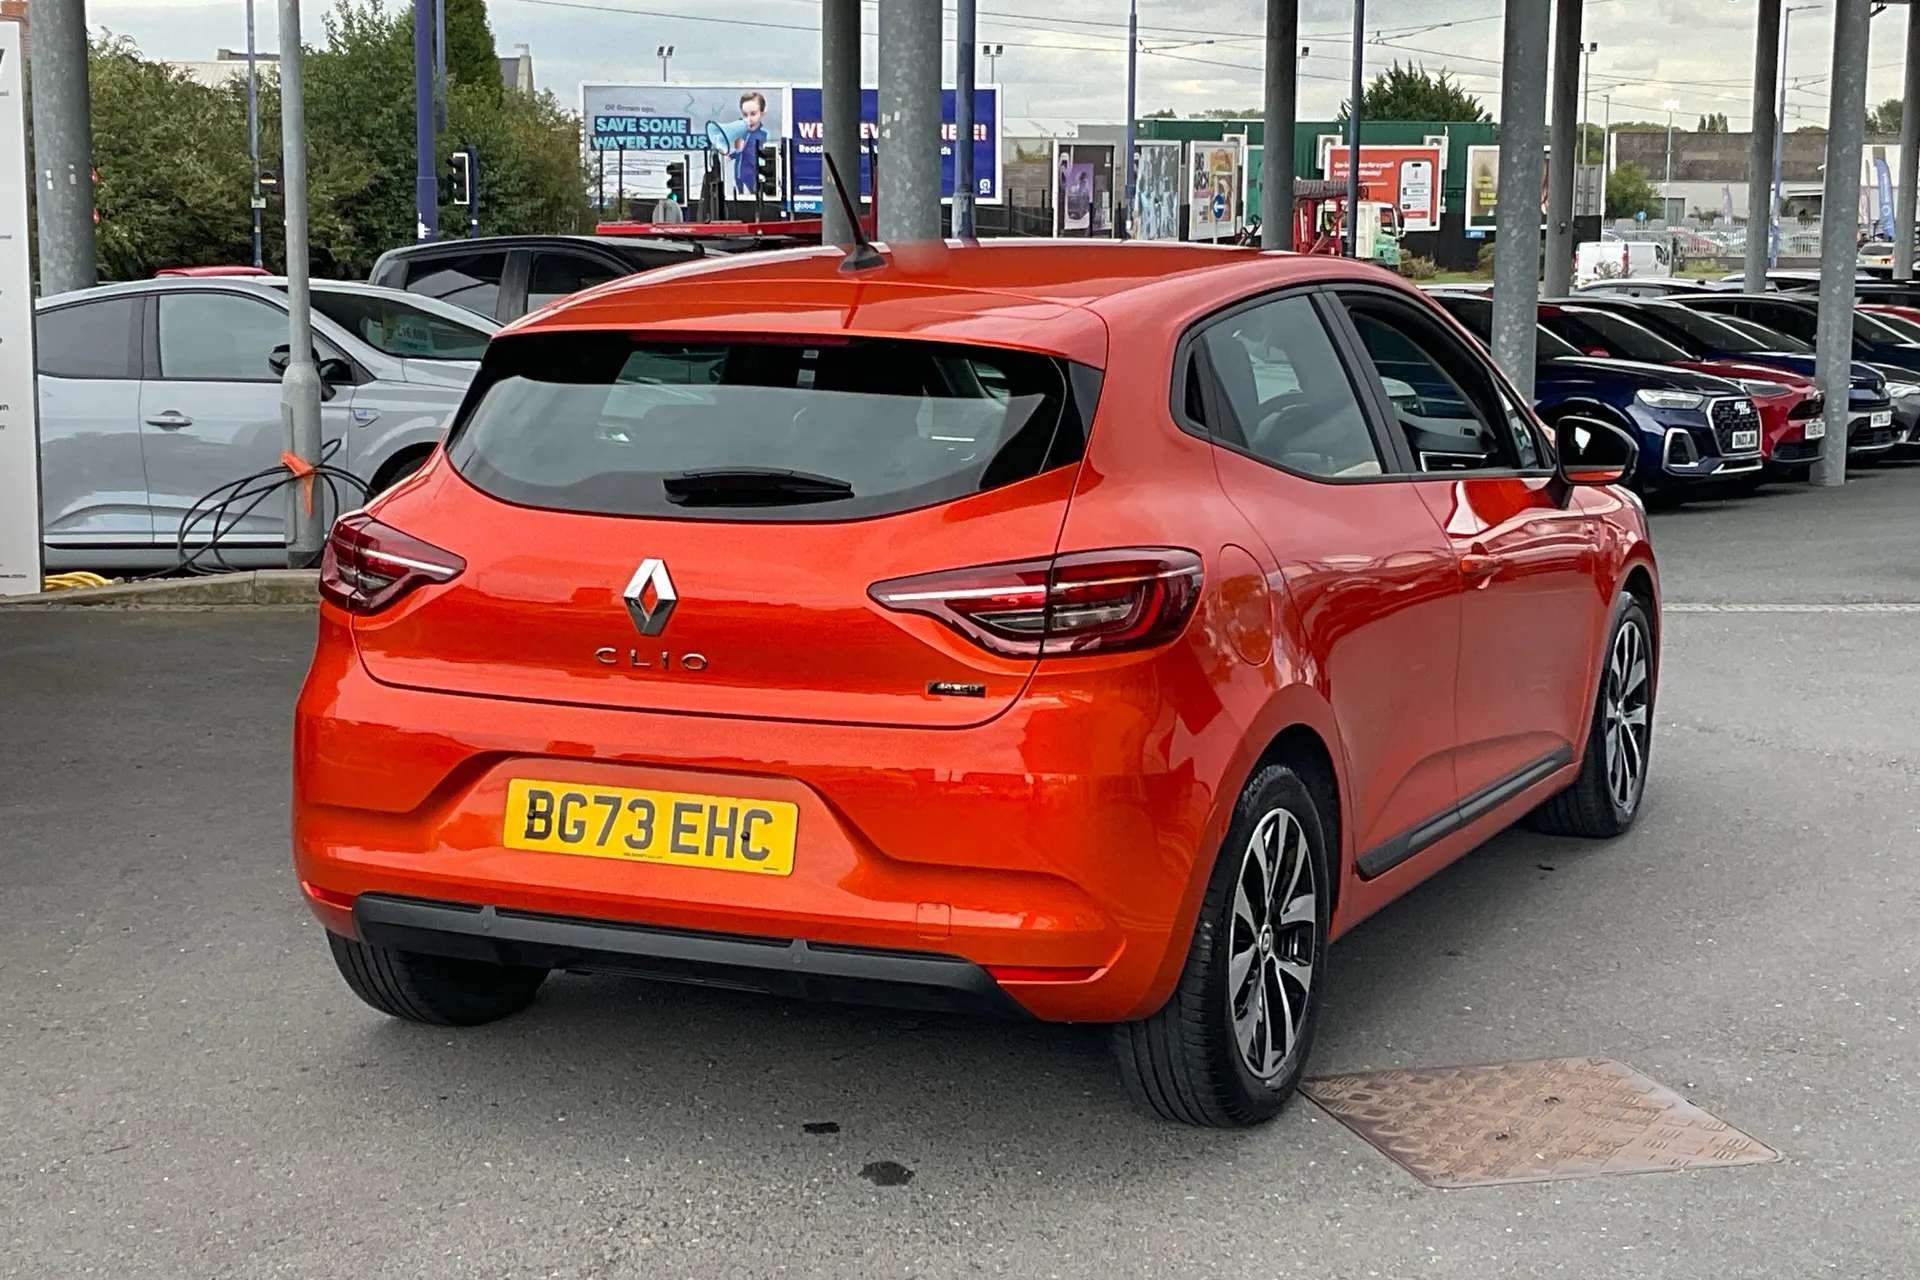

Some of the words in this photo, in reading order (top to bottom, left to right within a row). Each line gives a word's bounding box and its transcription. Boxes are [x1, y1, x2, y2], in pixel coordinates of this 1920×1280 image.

[596, 117, 637, 132] SAVE
[639, 118, 687, 133] SOME
[593, 135, 649, 150] WATER
[651, 135, 684, 150] FOR
[686, 136, 708, 149] US
[794, 202, 816, 211] global
[594, 647, 708, 671] CLIO
[525, 789, 656, 850] BG73
[670, 801, 774, 861] EHC
